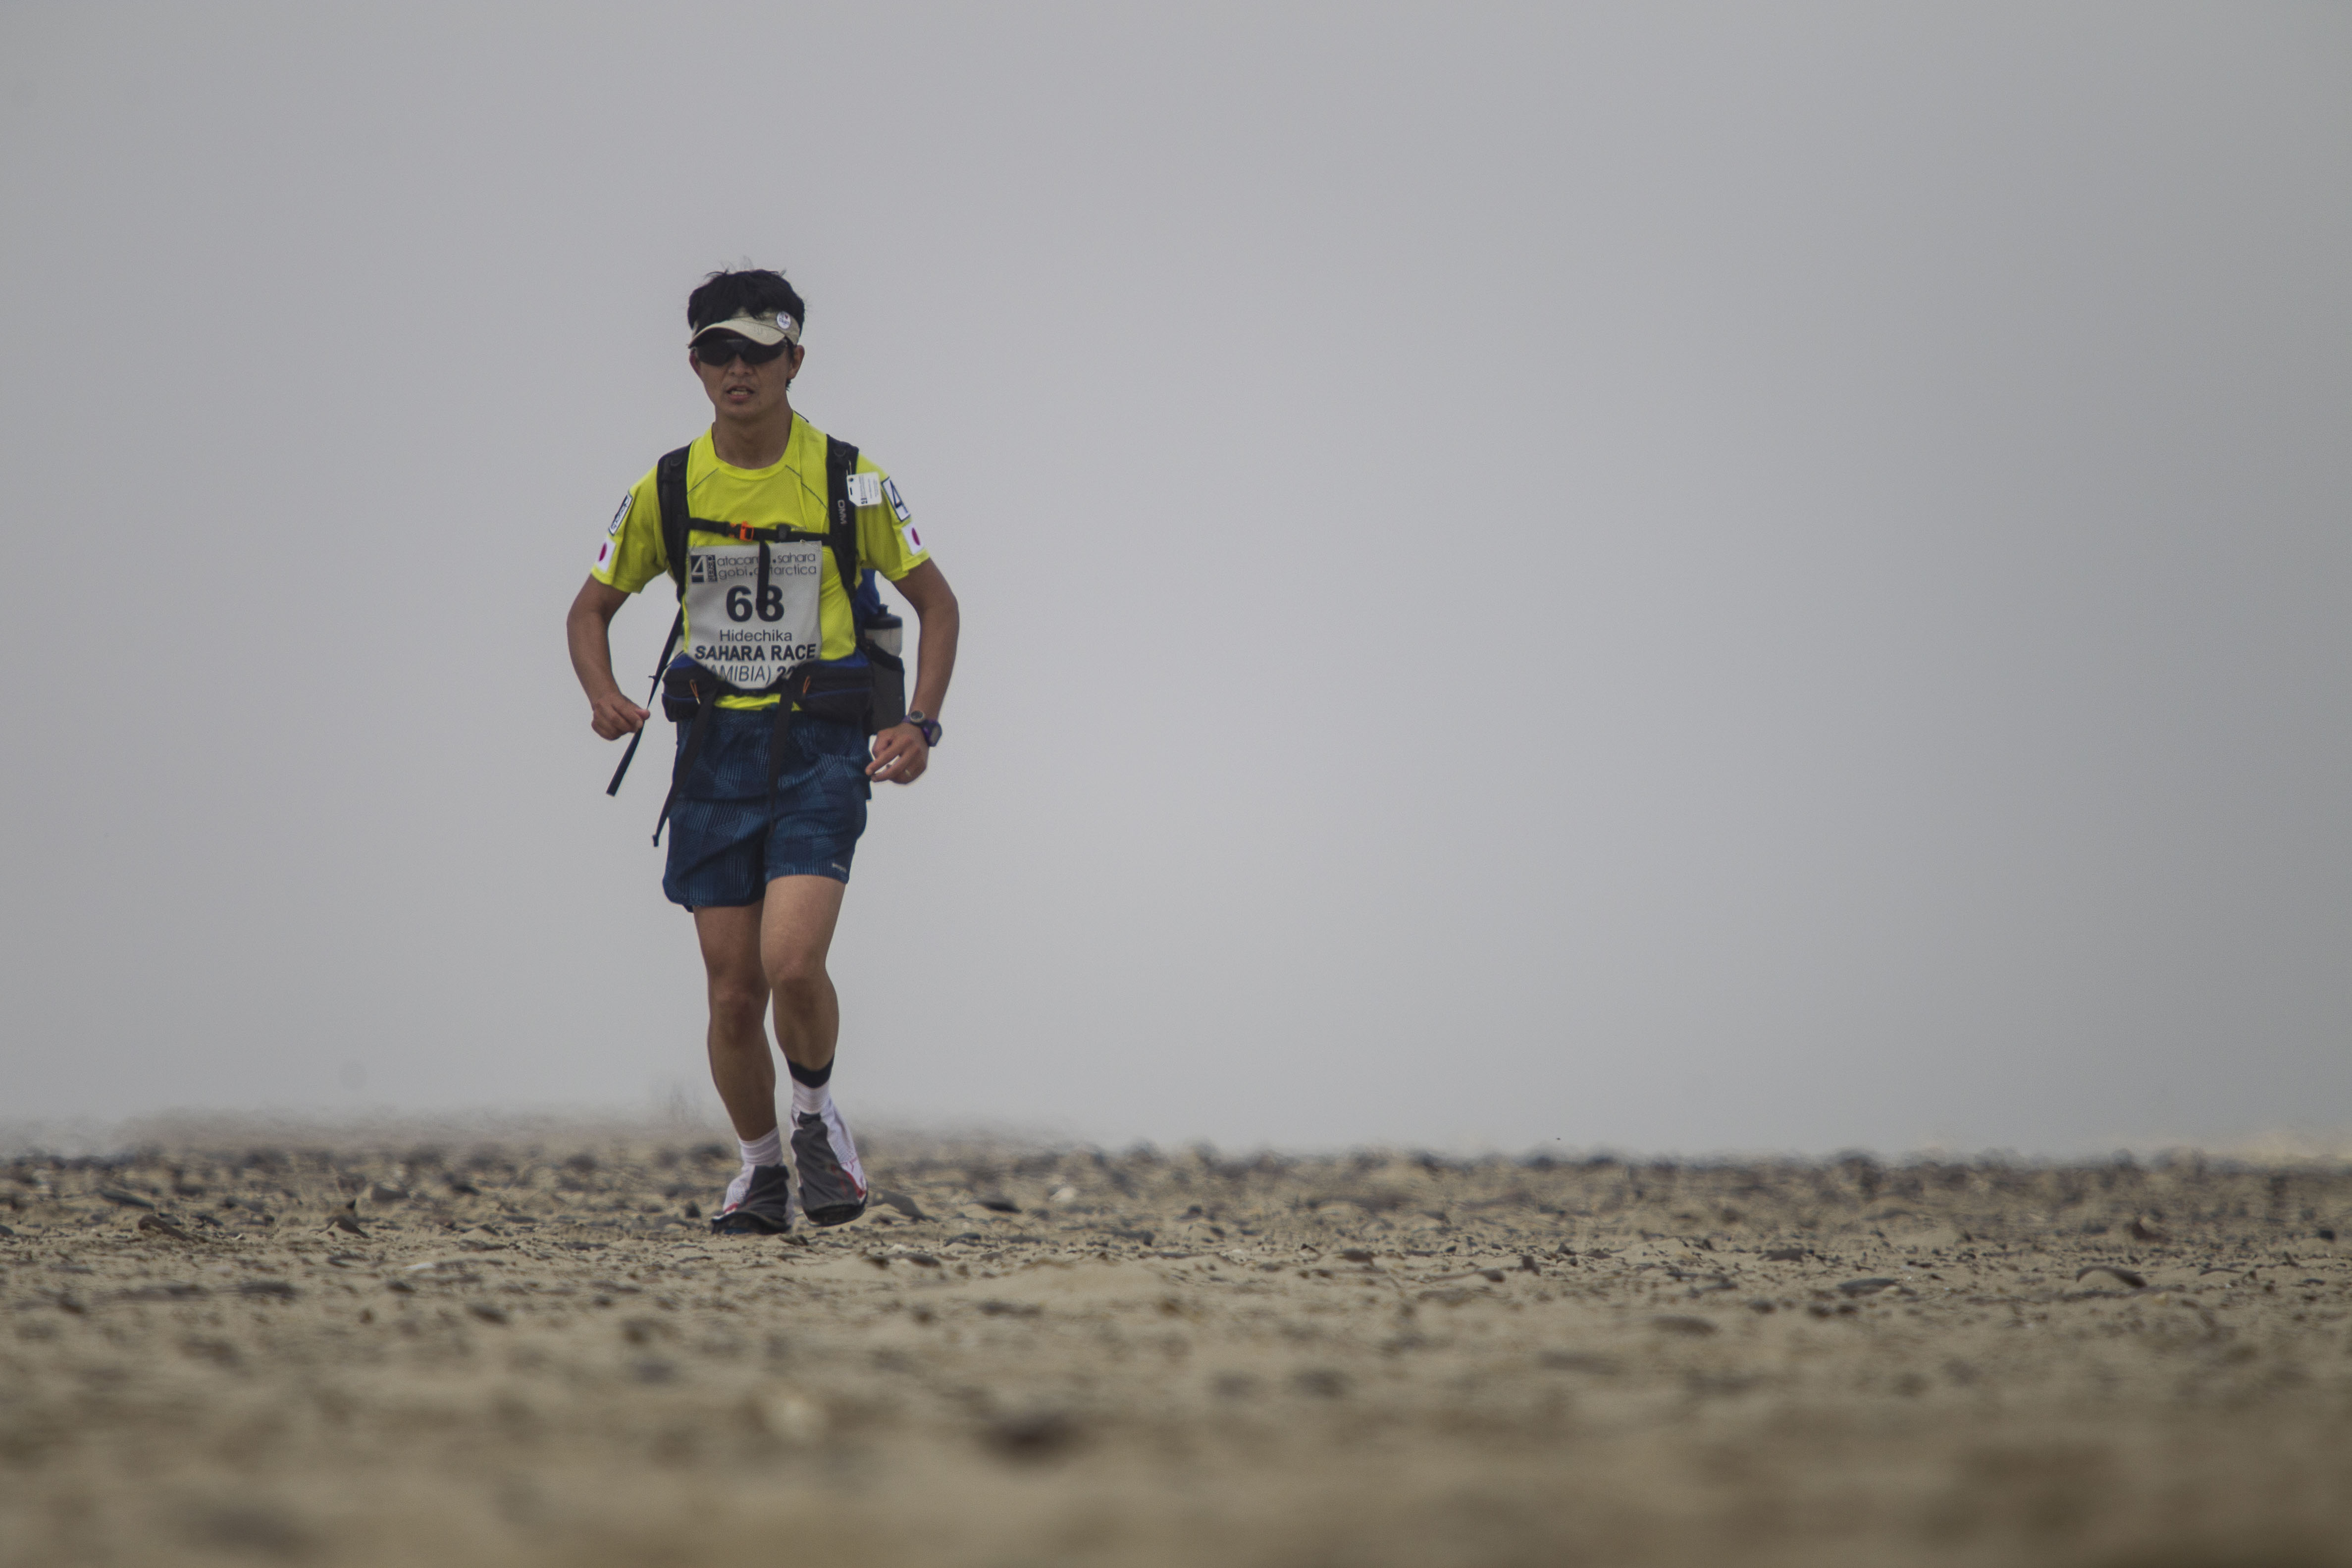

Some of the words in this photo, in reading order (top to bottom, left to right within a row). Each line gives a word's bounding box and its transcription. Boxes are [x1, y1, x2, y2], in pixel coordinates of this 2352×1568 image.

[726, 585, 784, 623] 68
[720, 629, 792, 642] Hidechika
[695, 645, 766, 661] SAHARA
[771, 643, 817, 661] RACE
